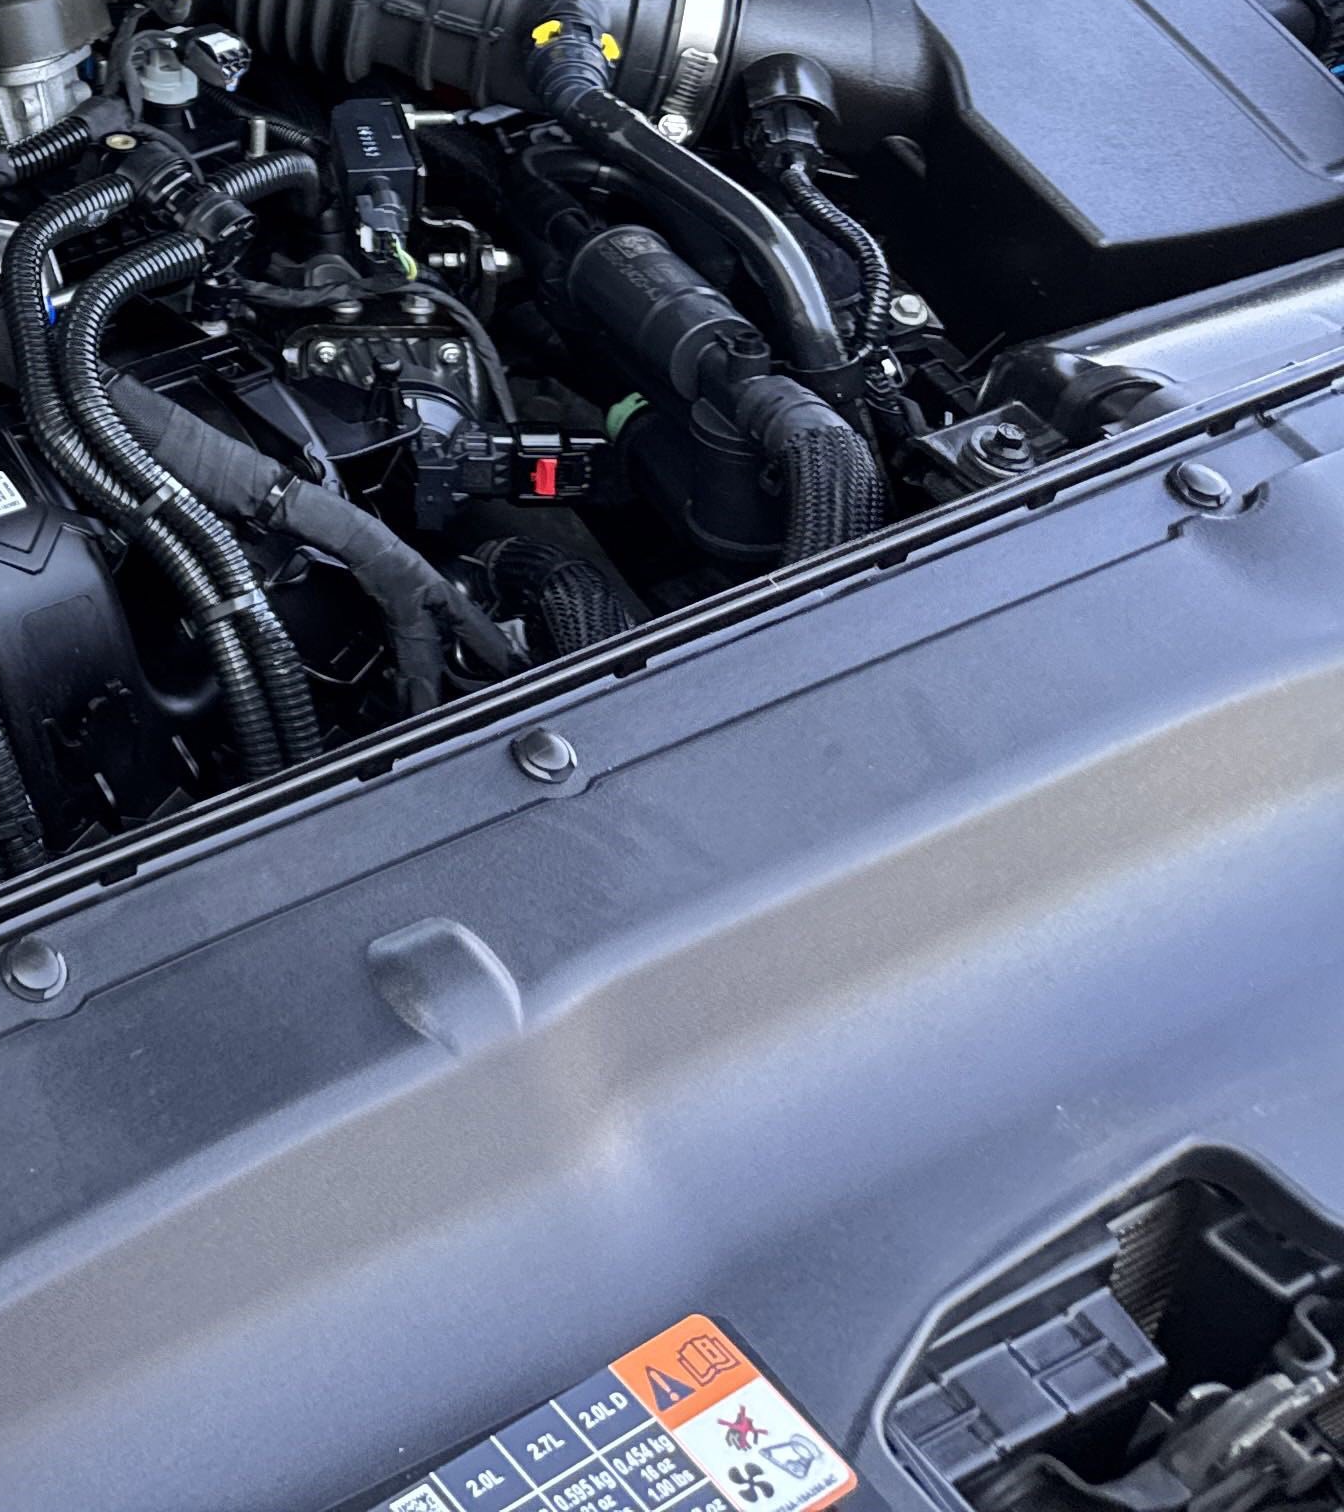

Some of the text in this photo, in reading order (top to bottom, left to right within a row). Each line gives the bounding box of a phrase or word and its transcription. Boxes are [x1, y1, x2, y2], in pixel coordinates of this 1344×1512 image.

[578, 1391, 629, 1430] 2.0L D
[526, 1433, 566, 1462] 2.7L
[612, 1433, 676, 1476] 0.454 kg
[465, 1469, 506, 1499] 2.0L
[640, 1458, 676, 1483] 16 oz
[648, 1469, 695, 1502] 1.00 lbs
[553, 1470, 617, 1511] 0.595 kg
[598, 1494, 617, 1511] oz
